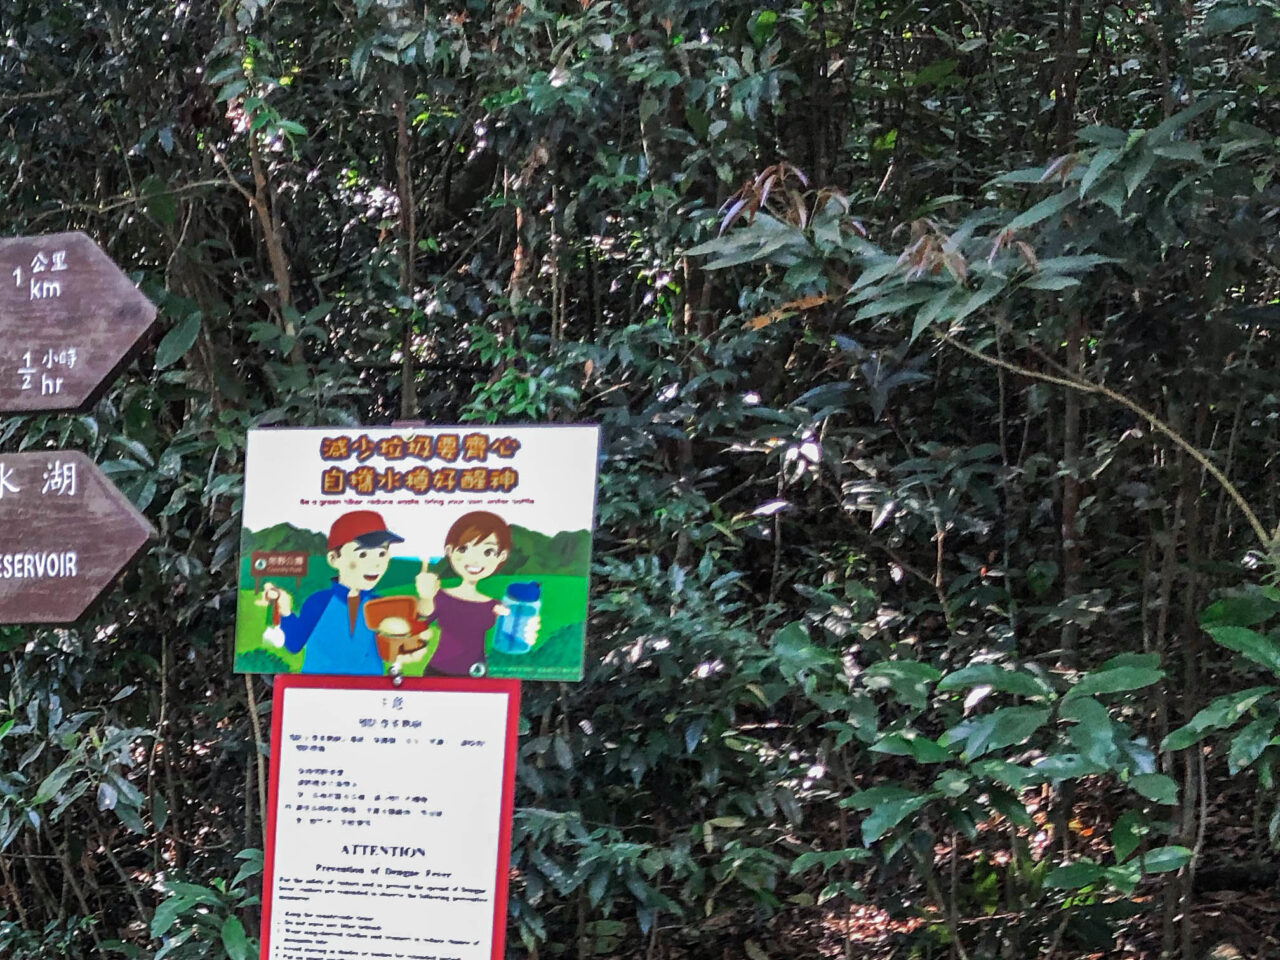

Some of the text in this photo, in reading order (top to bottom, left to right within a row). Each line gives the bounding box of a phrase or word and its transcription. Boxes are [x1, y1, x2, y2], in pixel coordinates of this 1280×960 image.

[13, 250, 68, 288] 1 公里
[30, 278, 61, 300] km
[41, 375, 65, 396] hr
[342, 844, 426, 858] ATTENTION
